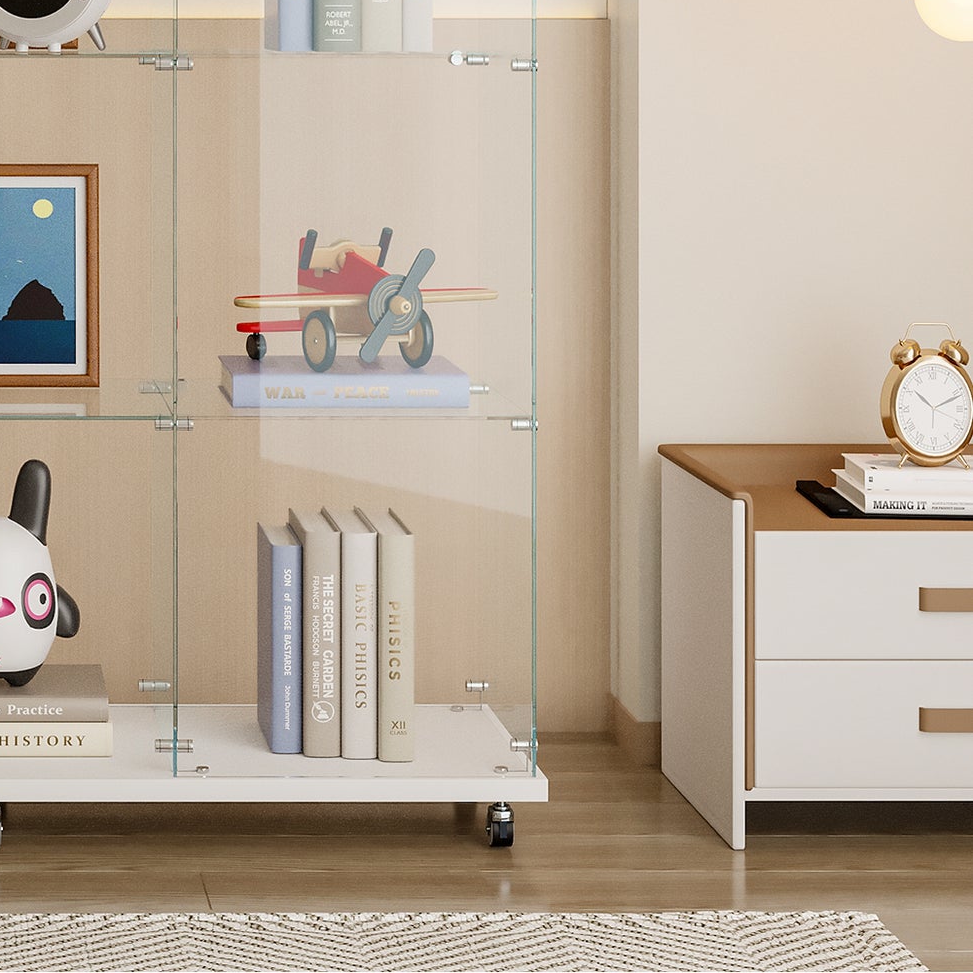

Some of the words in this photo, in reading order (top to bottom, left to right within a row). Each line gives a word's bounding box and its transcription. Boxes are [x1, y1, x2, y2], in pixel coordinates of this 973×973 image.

[264, 387, 306, 399] WAR
[333, 386, 389, 399] PEACE
[873, 501, 914, 510] MAKING
[917, 501, 927, 510] IT
[283, 569, 291, 587] SON
[323, 575, 334, 597] THE
[283, 593, 291, 602] of
[355, 584, 367, 632] BASIC
[283, 606, 291, 630] SERGE
[323, 599, 334, 643] SECRET
[389, 601, 400, 680] PHISICS
[283, 634, 291, 676] BASTARDE
[323, 650, 334, 698] GARDEN
[355, 642, 367, 709] PHISICS
[7, 704, 63, 715] Practice
[391, 721, 405, 730] XII
